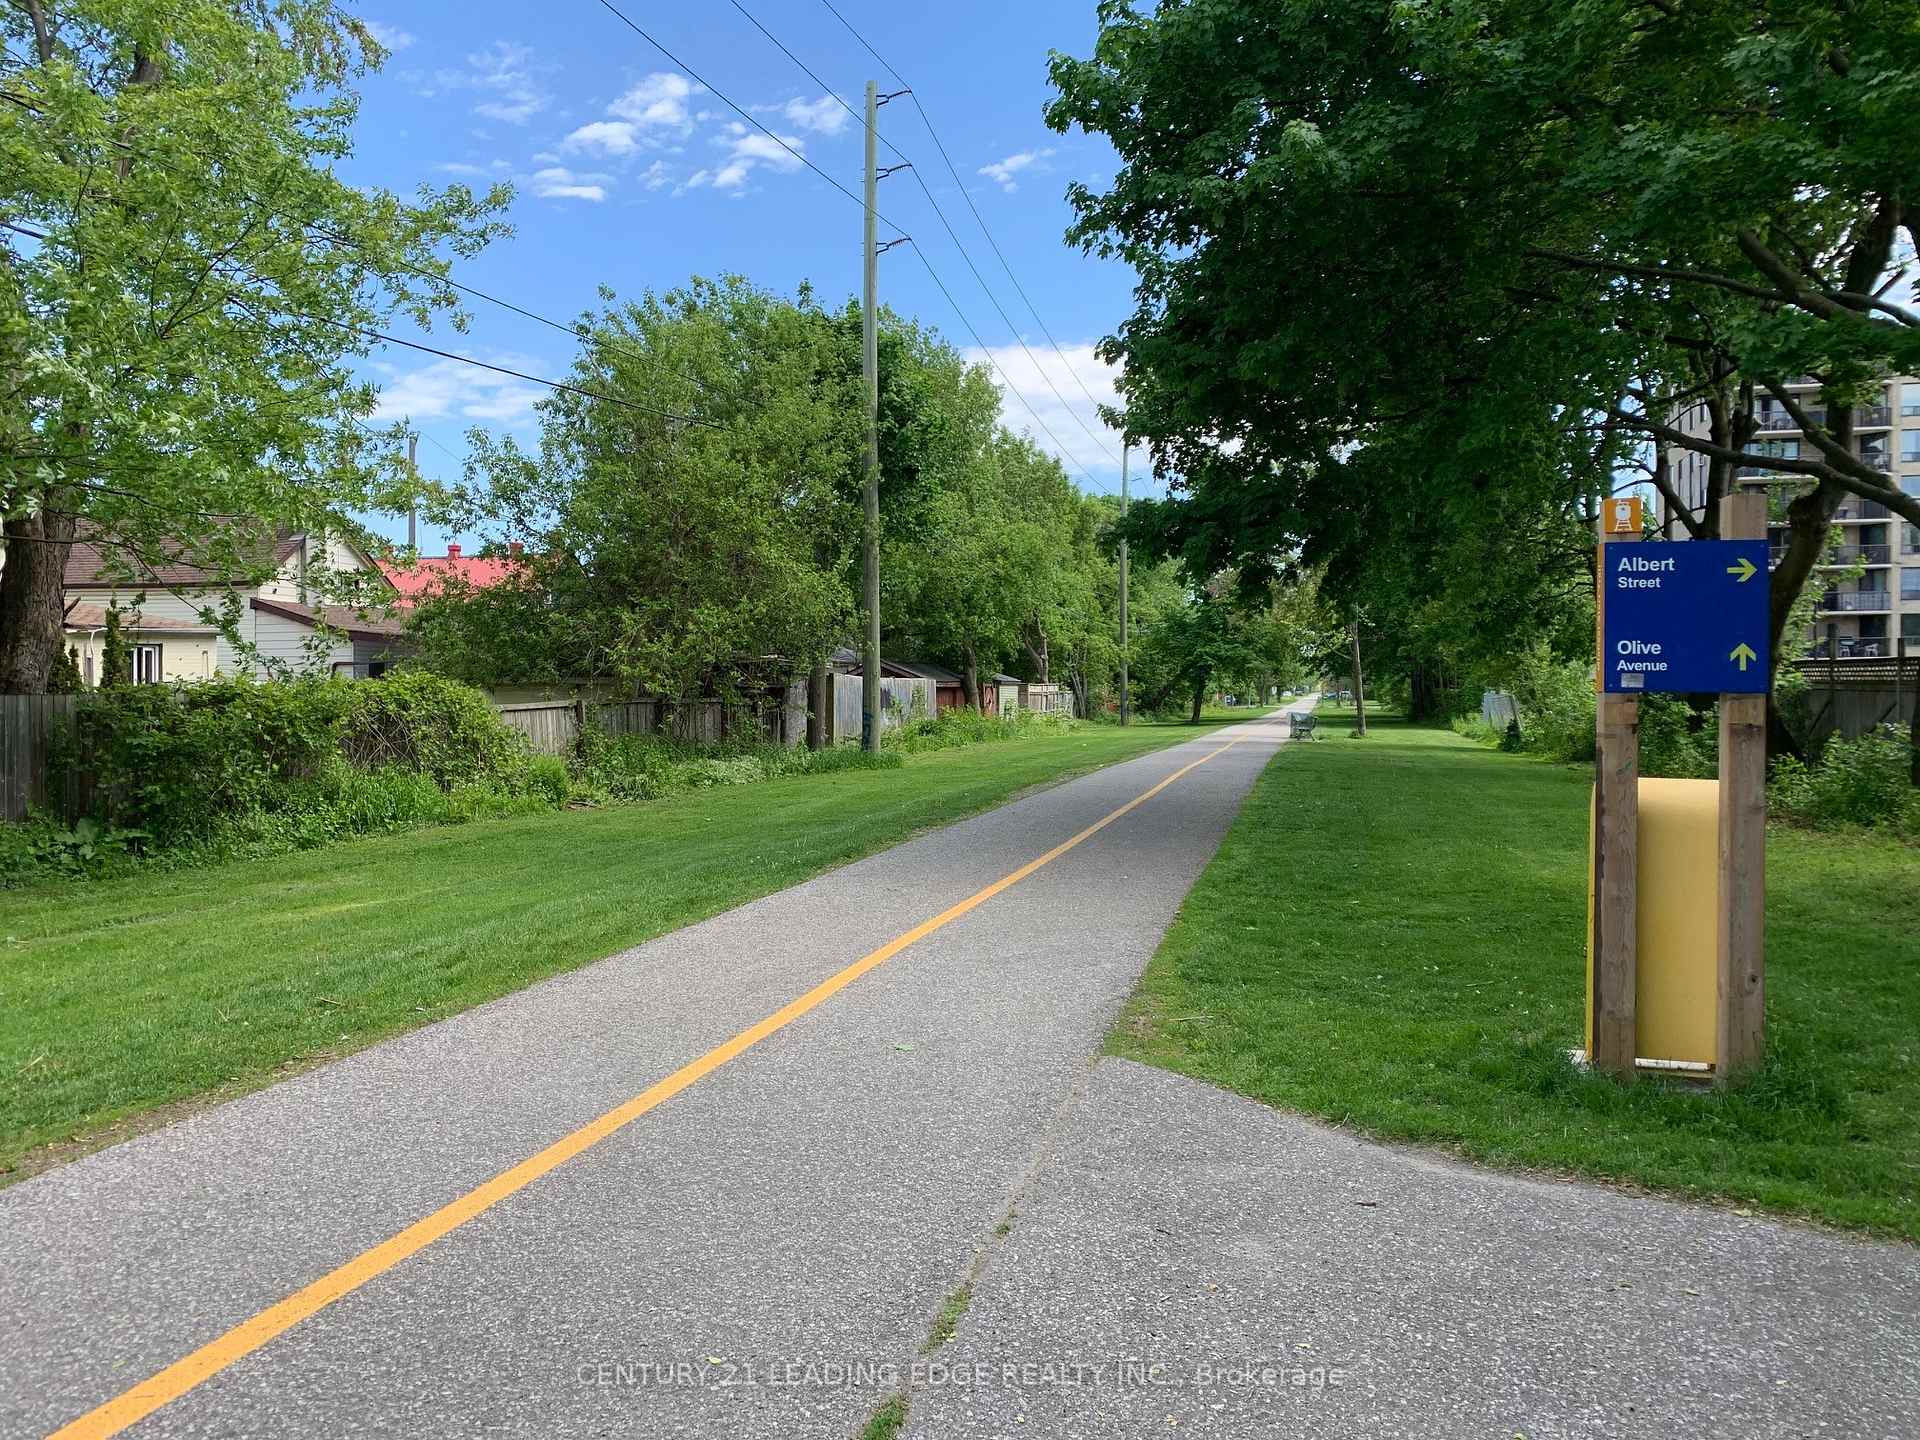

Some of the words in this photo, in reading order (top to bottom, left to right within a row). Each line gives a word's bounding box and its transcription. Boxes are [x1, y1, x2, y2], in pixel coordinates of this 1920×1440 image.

[1618, 557, 1675, 572] Albert
[1618, 577, 1661, 588] Street
[1617, 640, 1662, 655] Olive
[1617, 660, 1667, 671] Avenue
